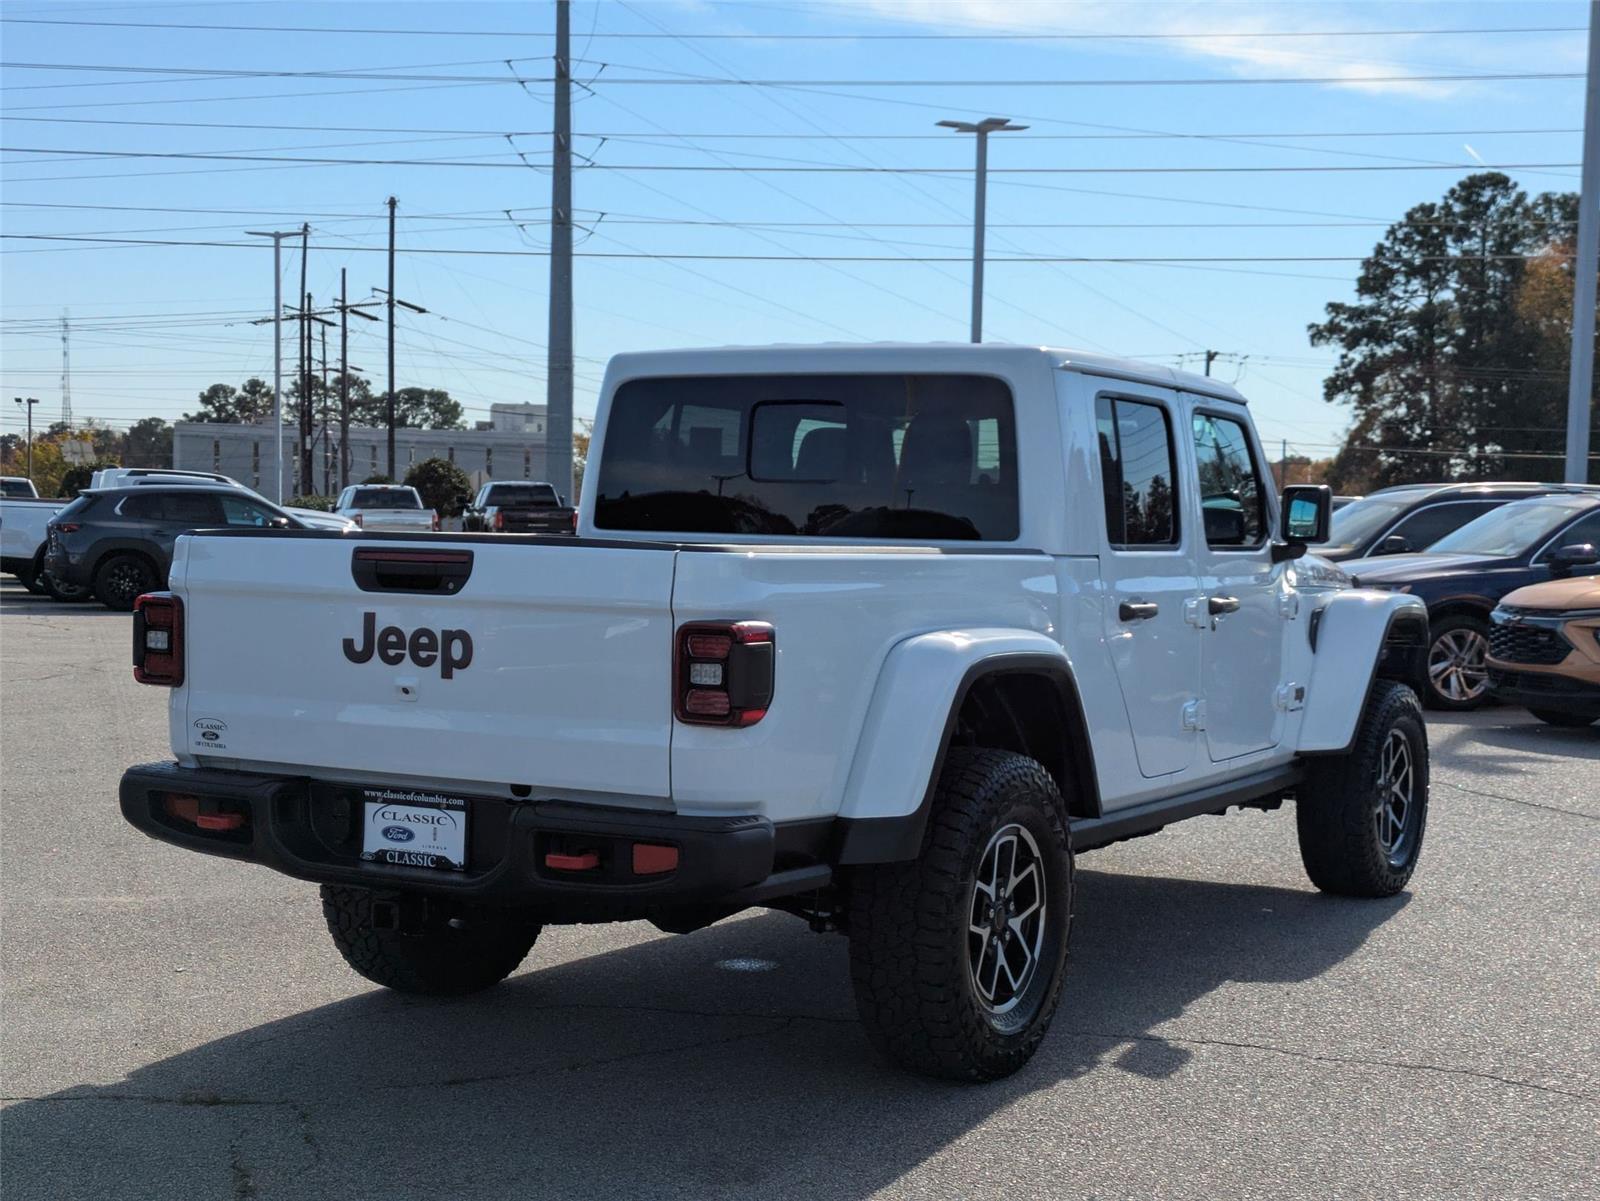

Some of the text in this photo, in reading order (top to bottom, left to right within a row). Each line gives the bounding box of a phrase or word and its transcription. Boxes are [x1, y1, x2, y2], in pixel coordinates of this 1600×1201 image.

[342, 612, 473, 680] Jeep
[195, 722, 225, 731] CLASSIC
[364, 790, 464, 806] www.classicofcolumbia.com
[381, 810, 448, 826] CLASSIC
[387, 828, 408, 840] Ford
[386, 851, 437, 868] CLASSIC
